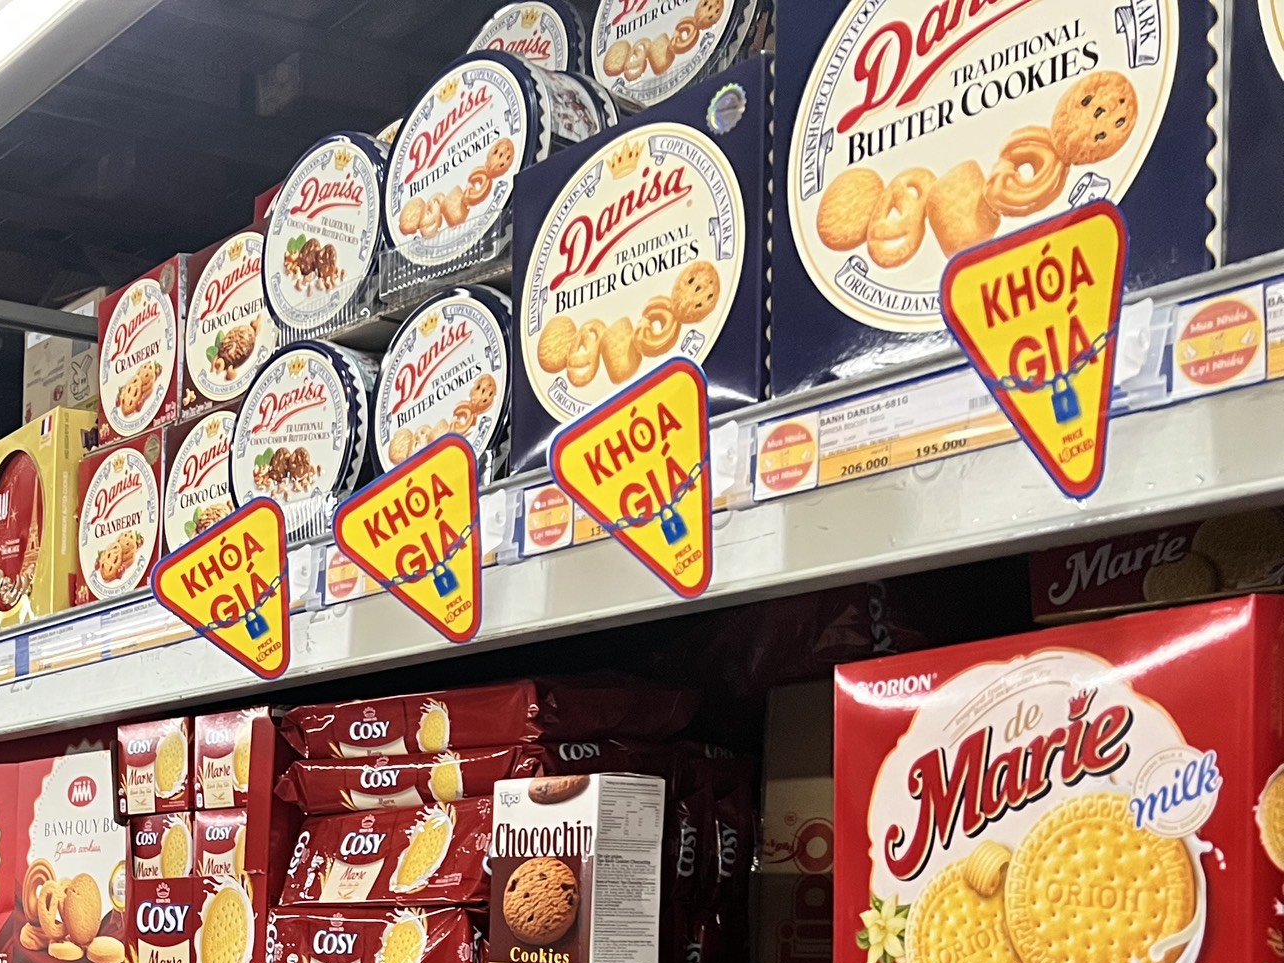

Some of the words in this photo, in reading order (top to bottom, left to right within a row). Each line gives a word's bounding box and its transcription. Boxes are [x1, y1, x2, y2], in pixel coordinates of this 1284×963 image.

[951, 18, 1085, 88] TRADITIONAL
[847, 106, 953, 166] BUTTER
[962, 41, 1099, 116] COOKIES
[404, 86, 493, 184] Danisa
[447, 118, 495, 157] TRADITIONAL
[408, 163, 451, 197] BUTTER
[451, 127, 501, 169] COOKIES
[290, 173, 364, 219] Danisa
[550, 166, 693, 291] Danisa
[615, 224, 692, 266] TRADITIONAL
[200, 256, 262, 322] Danisa
[555, 270, 617, 315] BUTTER
[620, 240, 700, 286] COOKIES
[980, 244, 1095, 330] KHÓA
[110, 300, 161, 363] Danisa
[1009, 303, 1102, 393] GIÁ
[115, 338, 162, 376] CRANBERRY
[392, 320, 472, 414] Danisa
[432, 354, 477, 390] TRADITIONAL
[252, 376, 328, 435] Danisa
[396, 396, 436, 429] BUTTER
[436, 362, 483, 402] COOKIES
[819, 412, 845, 427] BANH
[847, 395, 909, 421] DANISA-681G
[583, 401, 683, 486] KHÓA
[916, 438, 967, 458] 195.000
[619, 443, 698, 528] GIÁ
[841, 456, 889, 477] 206.000
[91, 469, 142, 525] Danisa
[363, 473, 455, 549] KHÓA
[94, 511, 145, 540] CRANBERRY
[395, 508, 468, 584] GIÁ
[180, 530, 265, 599] KHÓA
[1048, 531, 1189, 606] Marie
[210, 563, 277, 628] GIÁ
[872, 674, 933, 697] ORION
[206, 729, 233, 746] COSY
[349, 720, 390, 741] COSY
[1004, 700, 1043, 744] de
[127, 740, 154, 755] COSY
[559, 741, 602, 762] COSY
[129, 768, 154, 785] Marie
[205, 762, 231, 779] Marie
[360, 769, 400, 788] COSY
[884, 704, 1134, 881] Marie
[1130, 752, 1217, 828] milk
[500, 792, 521, 807] Tipo
[135, 831, 160, 847] COSY
[205, 825, 232, 841] COSY
[340, 832, 386, 856] COSY
[495, 818, 593, 863] Chocochip
[136, 861, 159, 877] Marie
[205, 859, 231, 875] Marie
[340, 868, 367, 882] Marie
[136, 902, 190, 934] COSY
[313, 929, 358, 955] COSY
